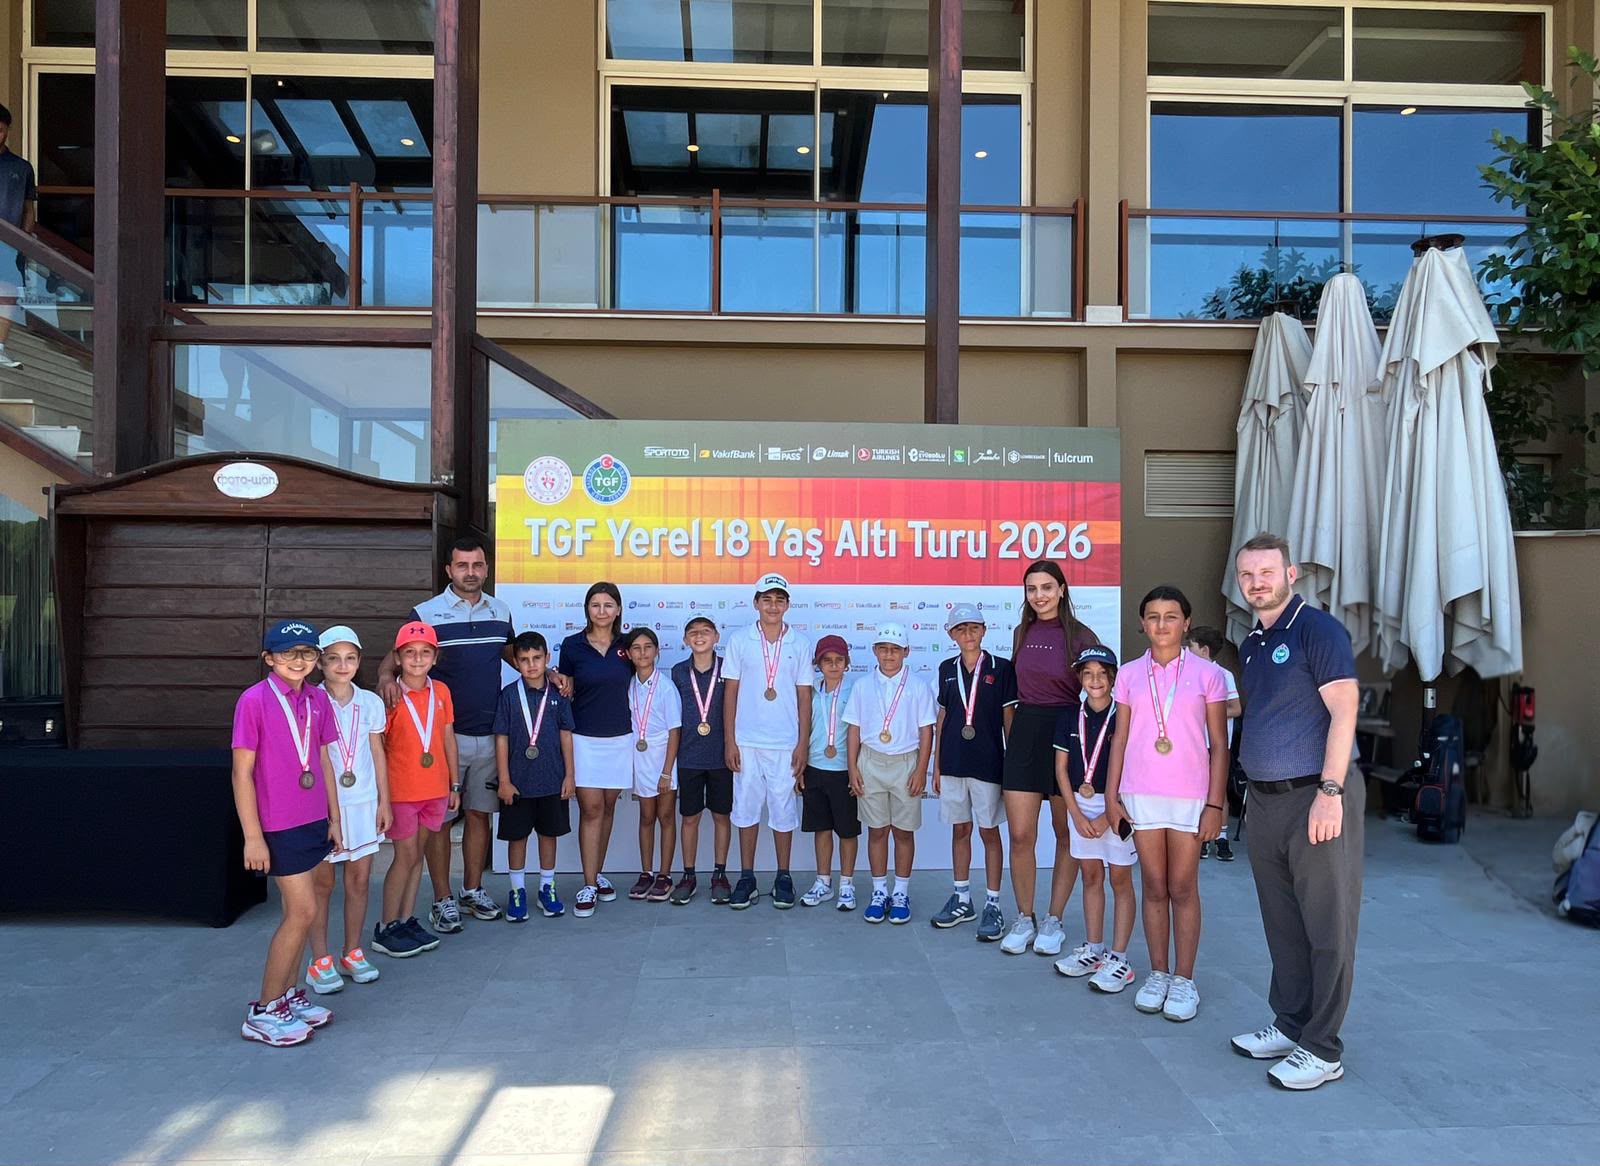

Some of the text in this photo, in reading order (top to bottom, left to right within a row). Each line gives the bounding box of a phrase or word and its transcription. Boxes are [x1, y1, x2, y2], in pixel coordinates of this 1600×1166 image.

[644, 447, 690, 459] SPORTOTO
[781, 452, 801, 461] PASS
[827, 449, 849, 458] Limak
[1053, 452, 1094, 463] fulcrum
[594, 477, 619, 487] TGF
[524, 518, 1092, 567] TGF Yerel 18 Yaş Altı Turu 2026
